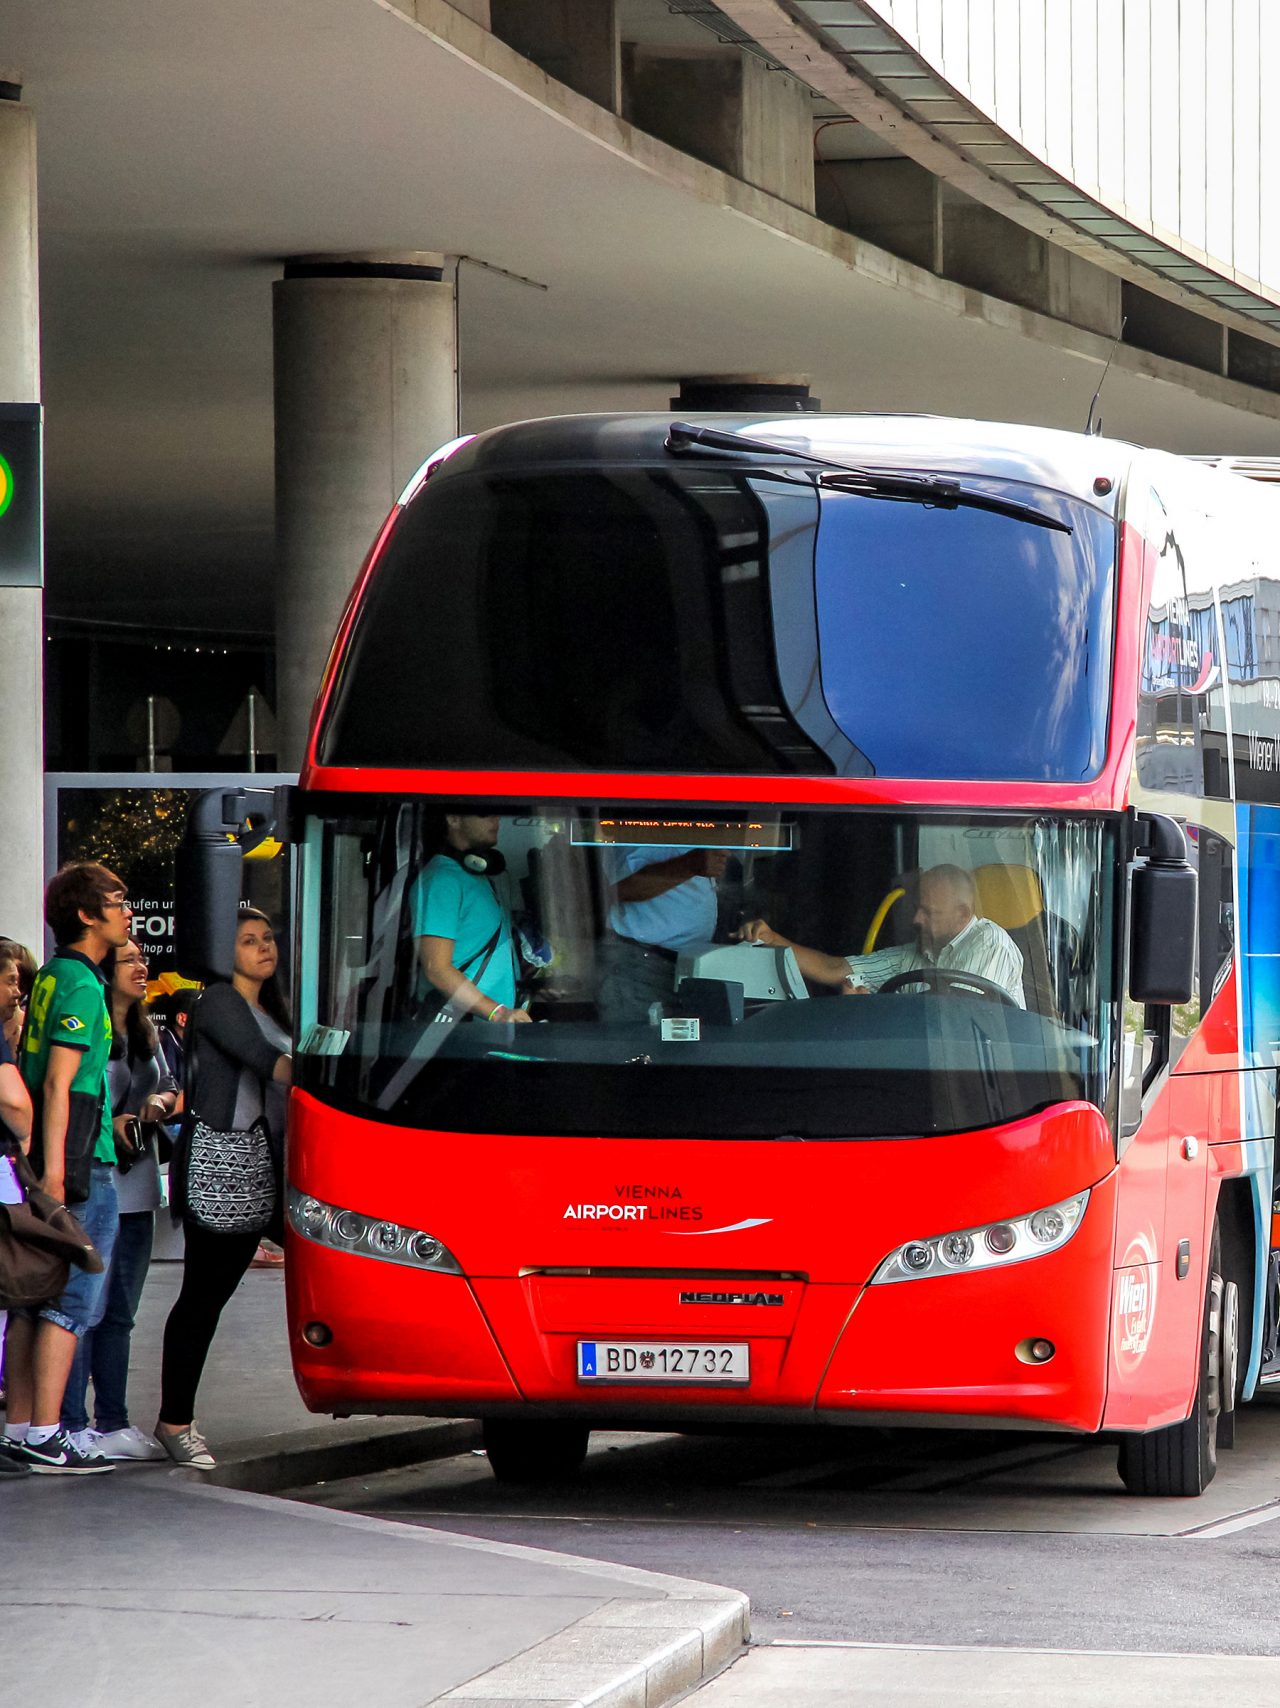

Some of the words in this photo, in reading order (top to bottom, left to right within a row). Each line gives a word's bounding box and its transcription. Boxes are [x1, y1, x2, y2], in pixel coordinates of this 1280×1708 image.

[1248, 729, 1275, 772] Wiener
[614, 1184, 683, 1199] VIENNA
[679, 1291, 785, 1306] NEOPLAN
[1119, 1275, 1148, 1315] Wien
[607, 1347, 637, 1373] BD
[658, 1348, 734, 1374] 12732
